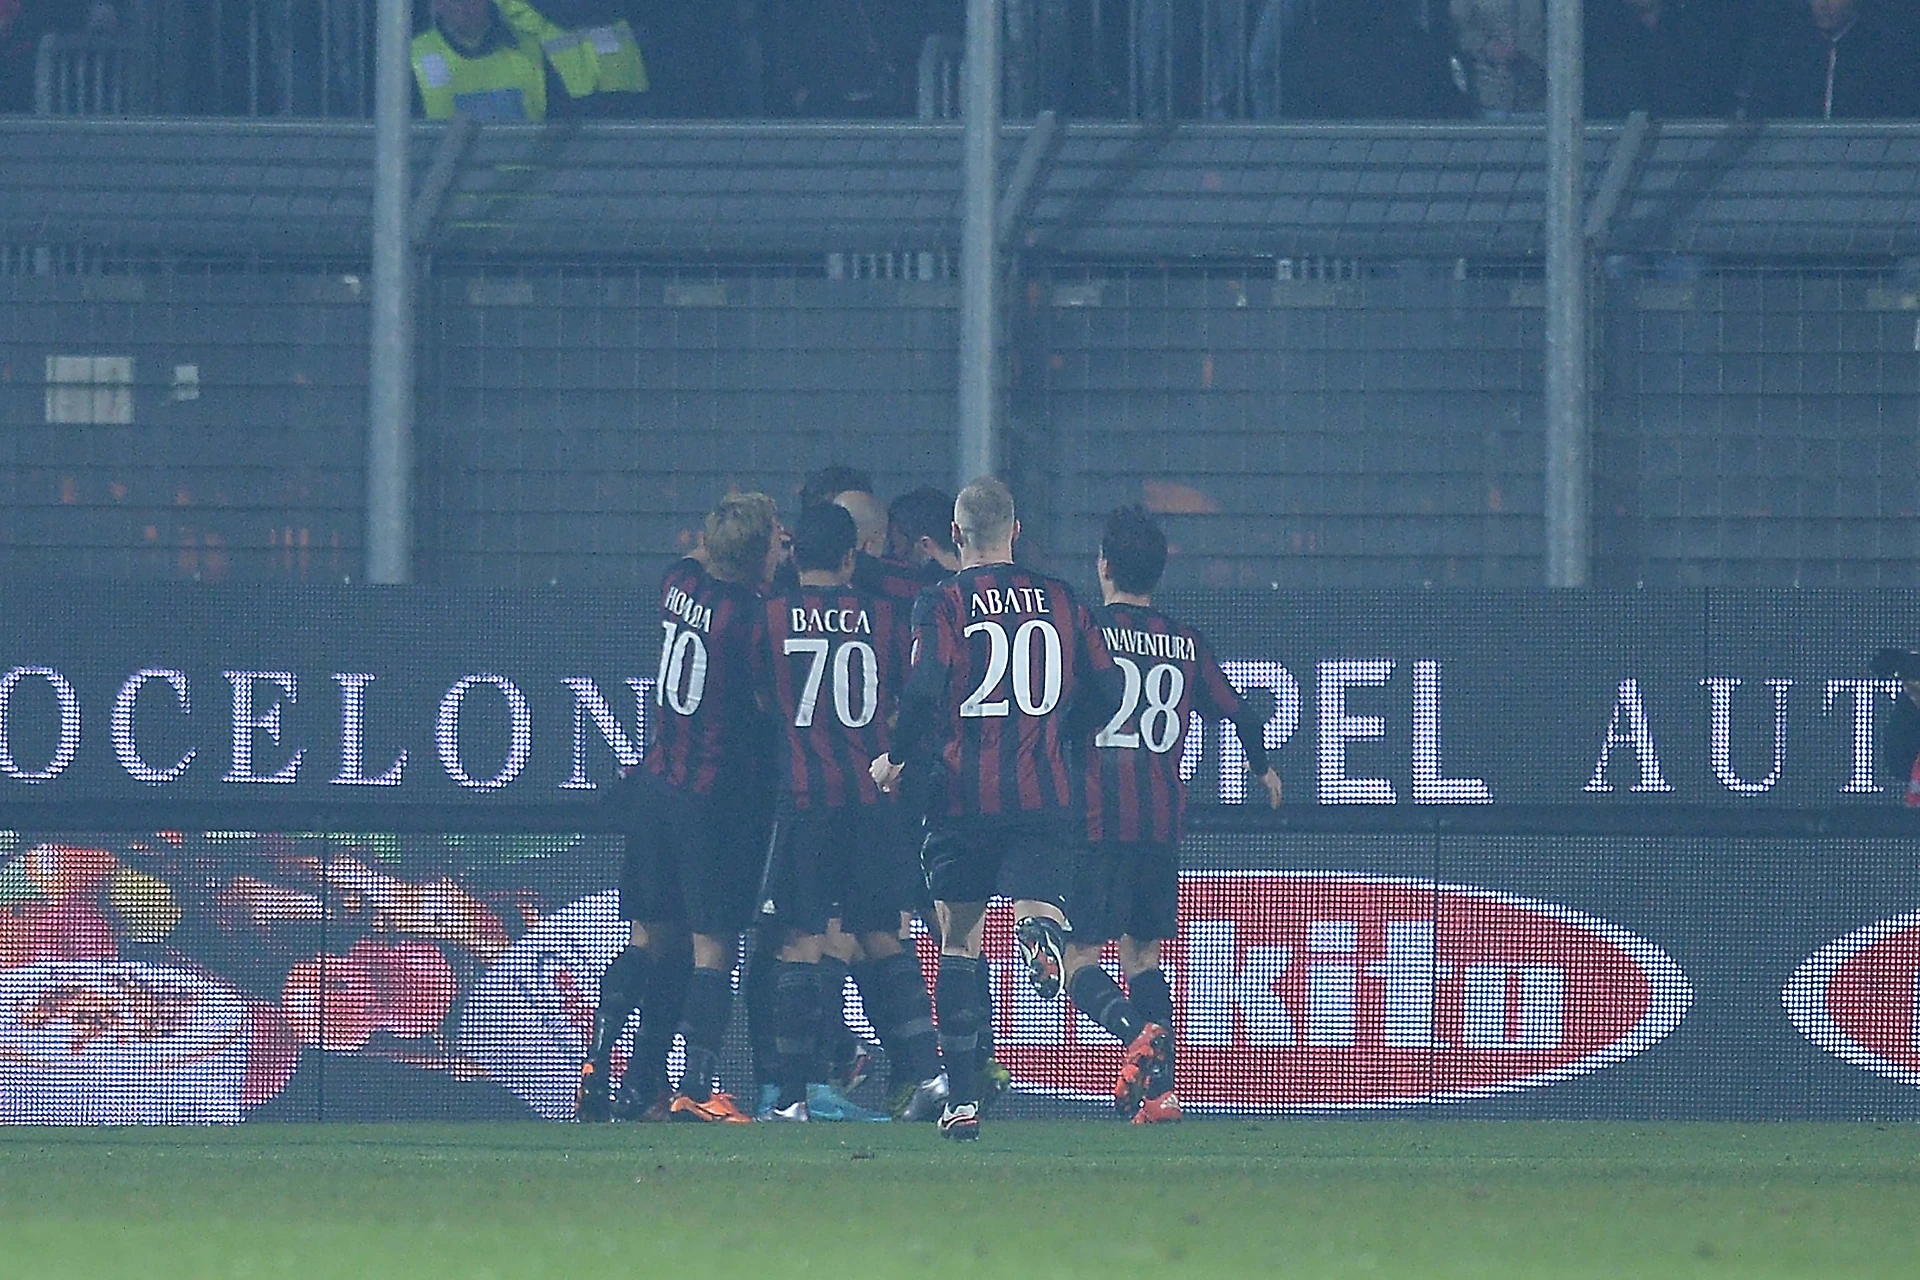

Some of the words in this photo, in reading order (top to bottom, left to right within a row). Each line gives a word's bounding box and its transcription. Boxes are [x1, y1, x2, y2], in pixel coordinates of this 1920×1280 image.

[793, 608, 871, 634] BACCA
[971, 587, 1050, 617] ABATE
[1102, 627, 1195, 662] NAVENTURA
[657, 620, 708, 716] 10
[784, 638, 879, 728] 70
[960, 619, 1063, 718] 20
[1095, 656, 1184, 753] 28
